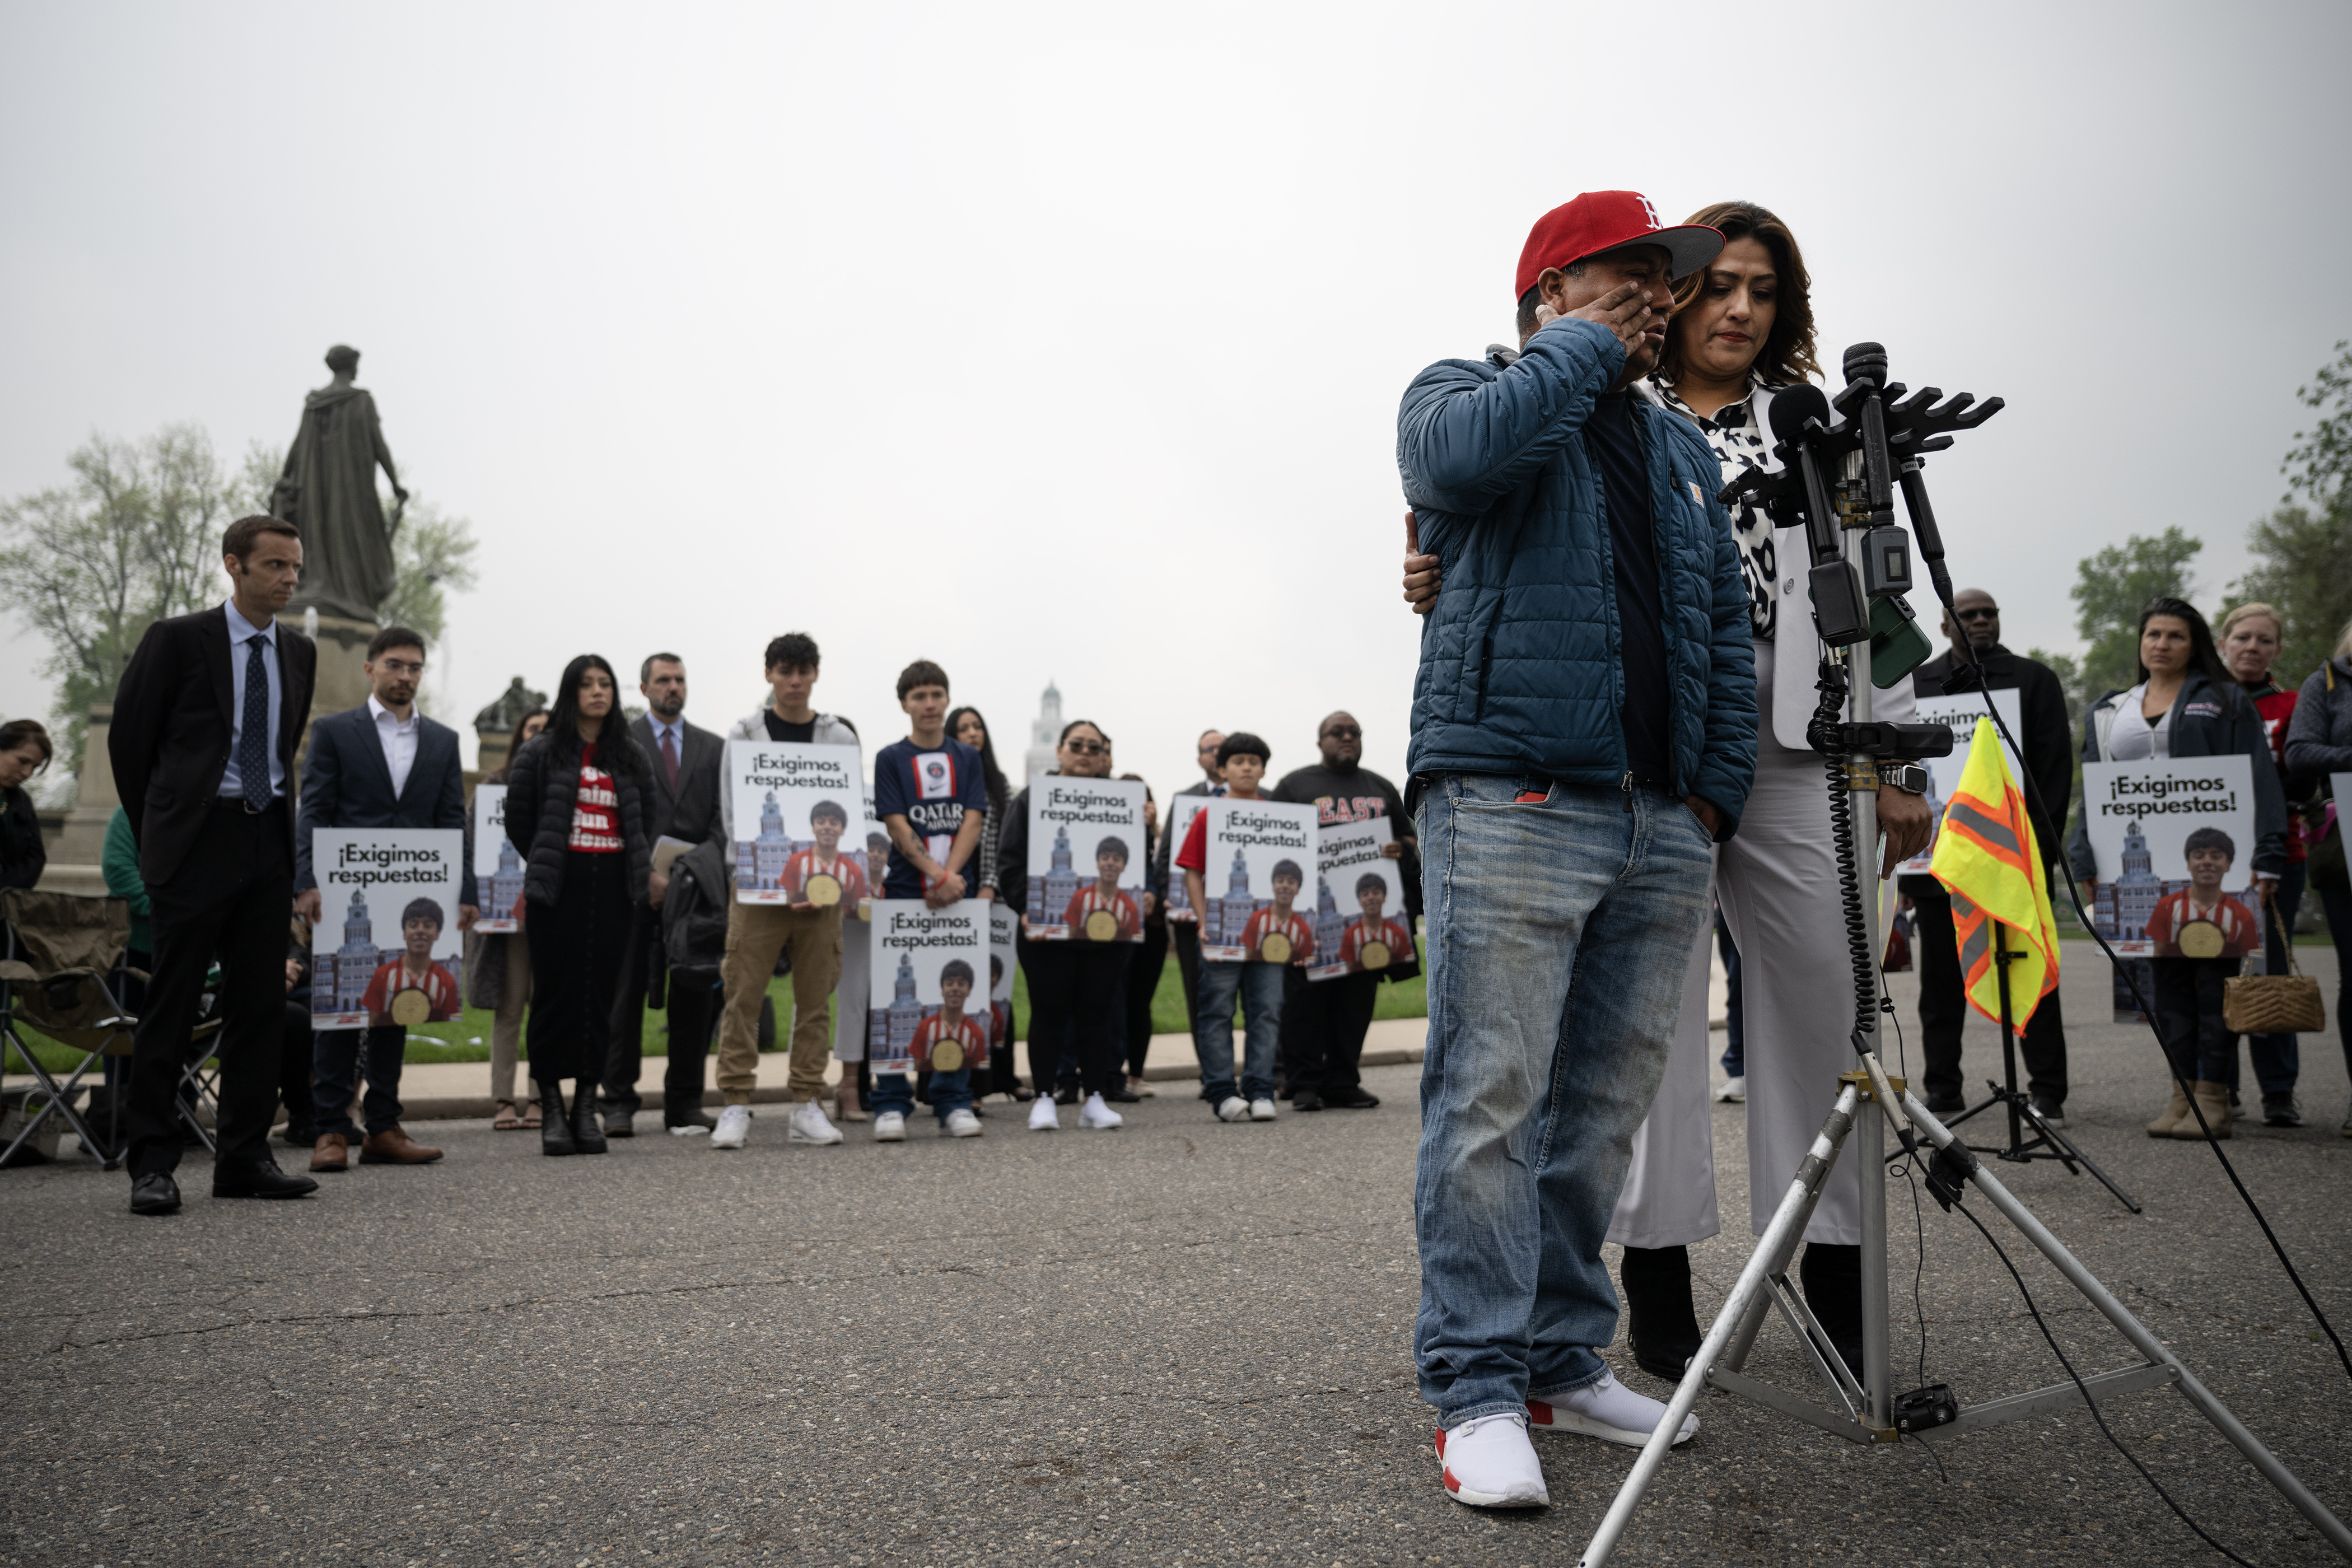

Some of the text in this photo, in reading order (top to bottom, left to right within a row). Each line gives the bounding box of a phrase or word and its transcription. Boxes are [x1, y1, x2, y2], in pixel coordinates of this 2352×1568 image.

[1636, 196, 1663, 230] B
[753, 754, 841, 774] ¡Exigimos
[745, 773, 849, 790] respuestas!
[2110, 773, 2225, 800] ¡Exigimos
[1049, 788, 1127, 809] ¡Exigimos
[1316, 796, 1384, 823] EAST
[2102, 791, 2236, 820] respuestas!
[1040, 809, 1133, 824] respuestas!
[1226, 811, 1300, 832] ¡Exigimos
[1219, 833, 1306, 848] respuestas!
[339, 843, 440, 867] ¡Exigimos
[328, 863, 448, 888] respuestas!
[891, 912, 970, 934] ¡Exigimos
[883, 928, 978, 951] respuestas!
